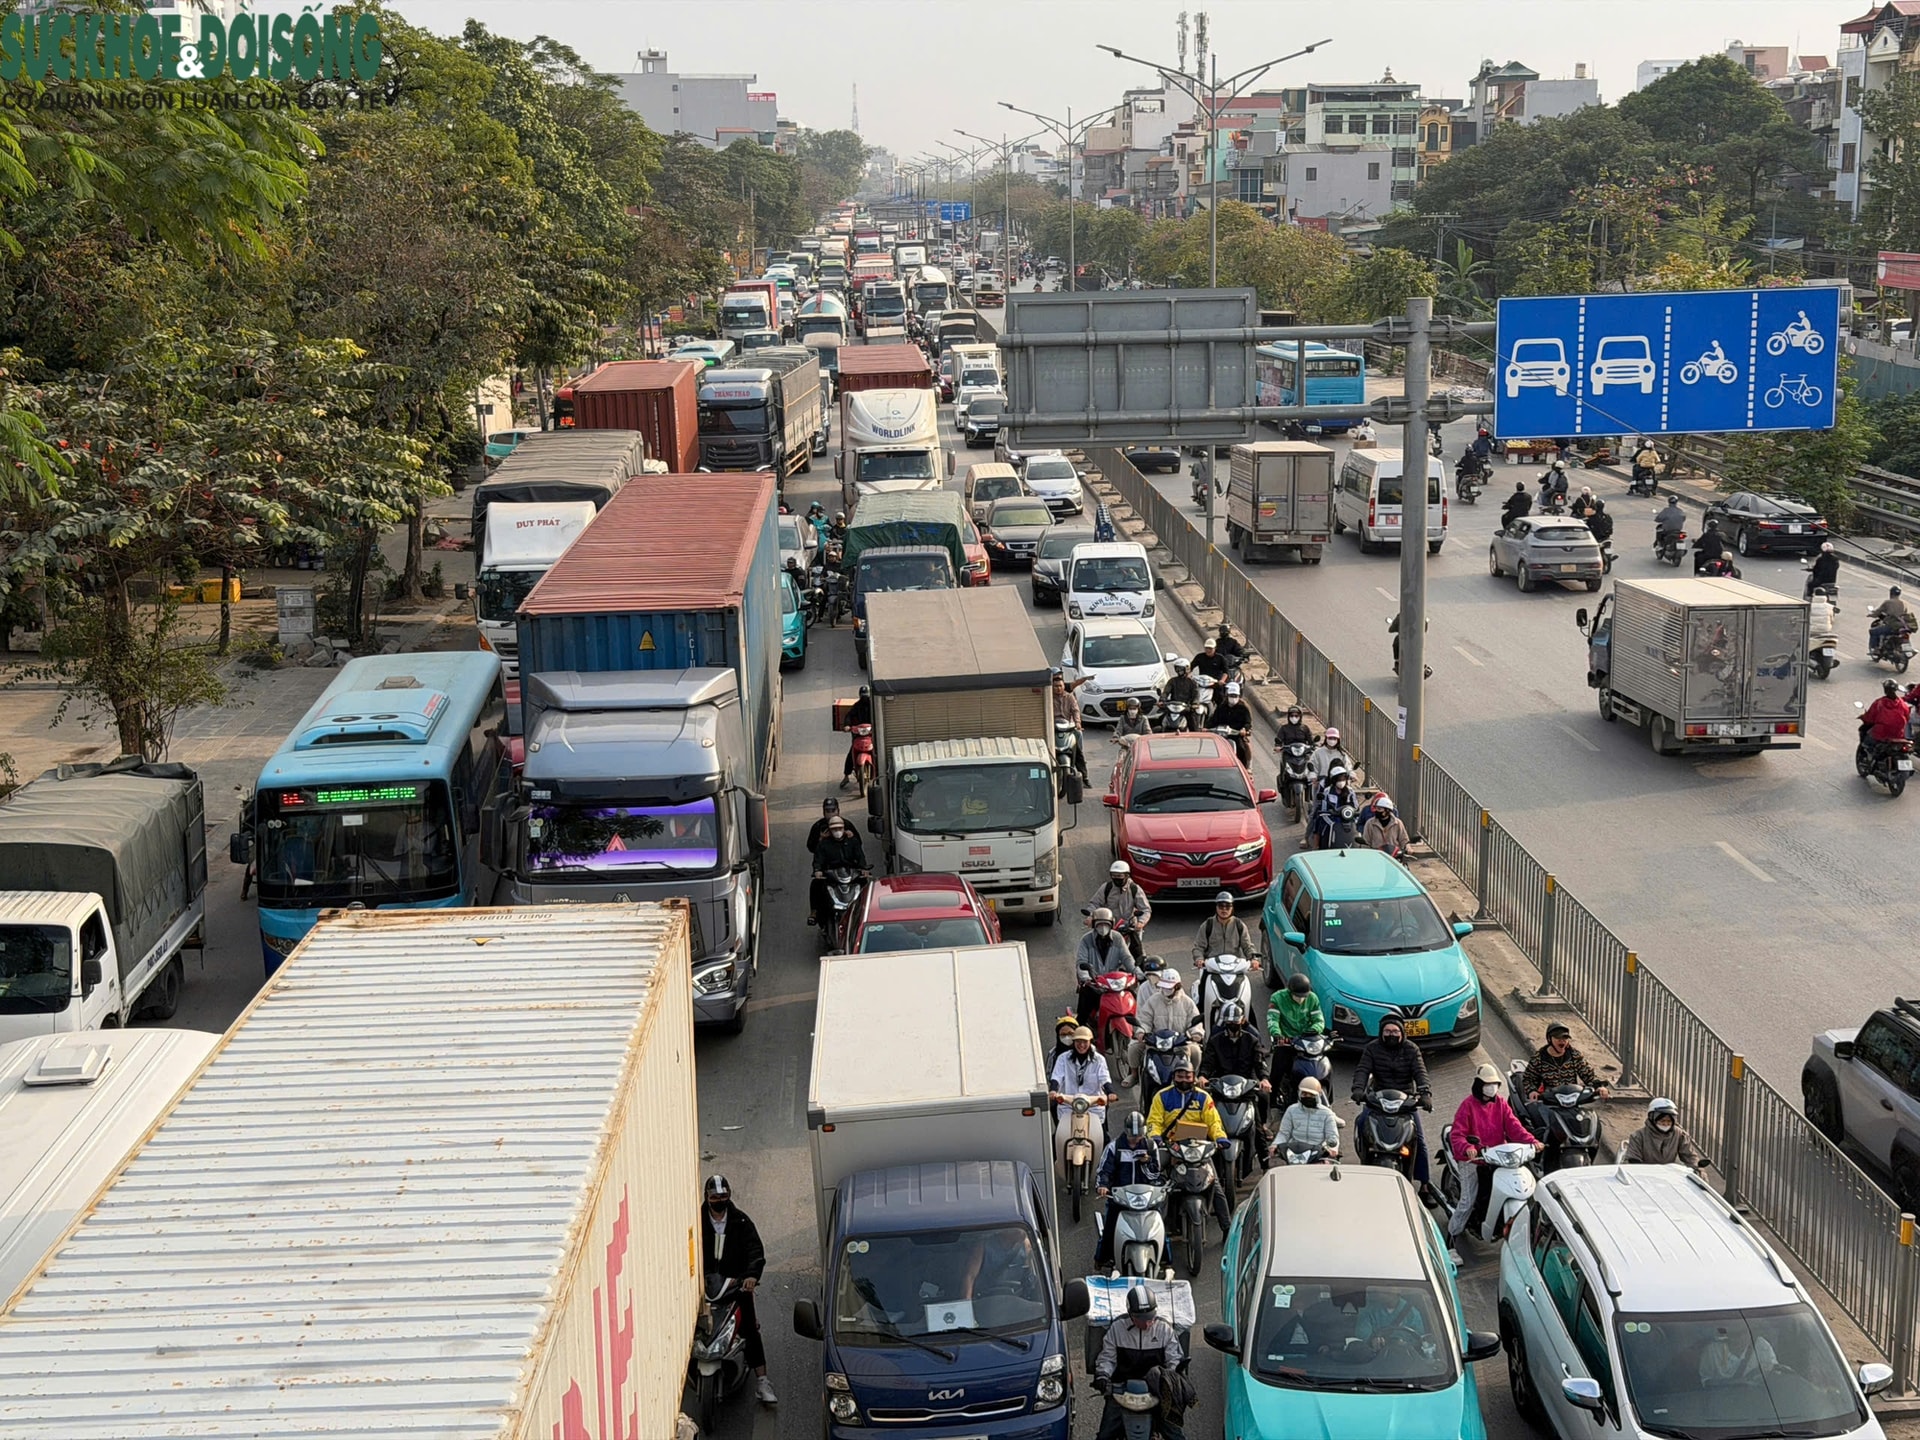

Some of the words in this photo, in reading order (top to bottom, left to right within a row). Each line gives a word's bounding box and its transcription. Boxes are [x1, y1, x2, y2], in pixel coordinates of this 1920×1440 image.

[871, 422, 916, 439] WORLDLINK
[516, 519, 535, 529] DUY
[961, 859, 996, 868] ISUZU
[1323, 919, 1342, 927] TAXI
[928, 1388, 965, 1400] KIA
